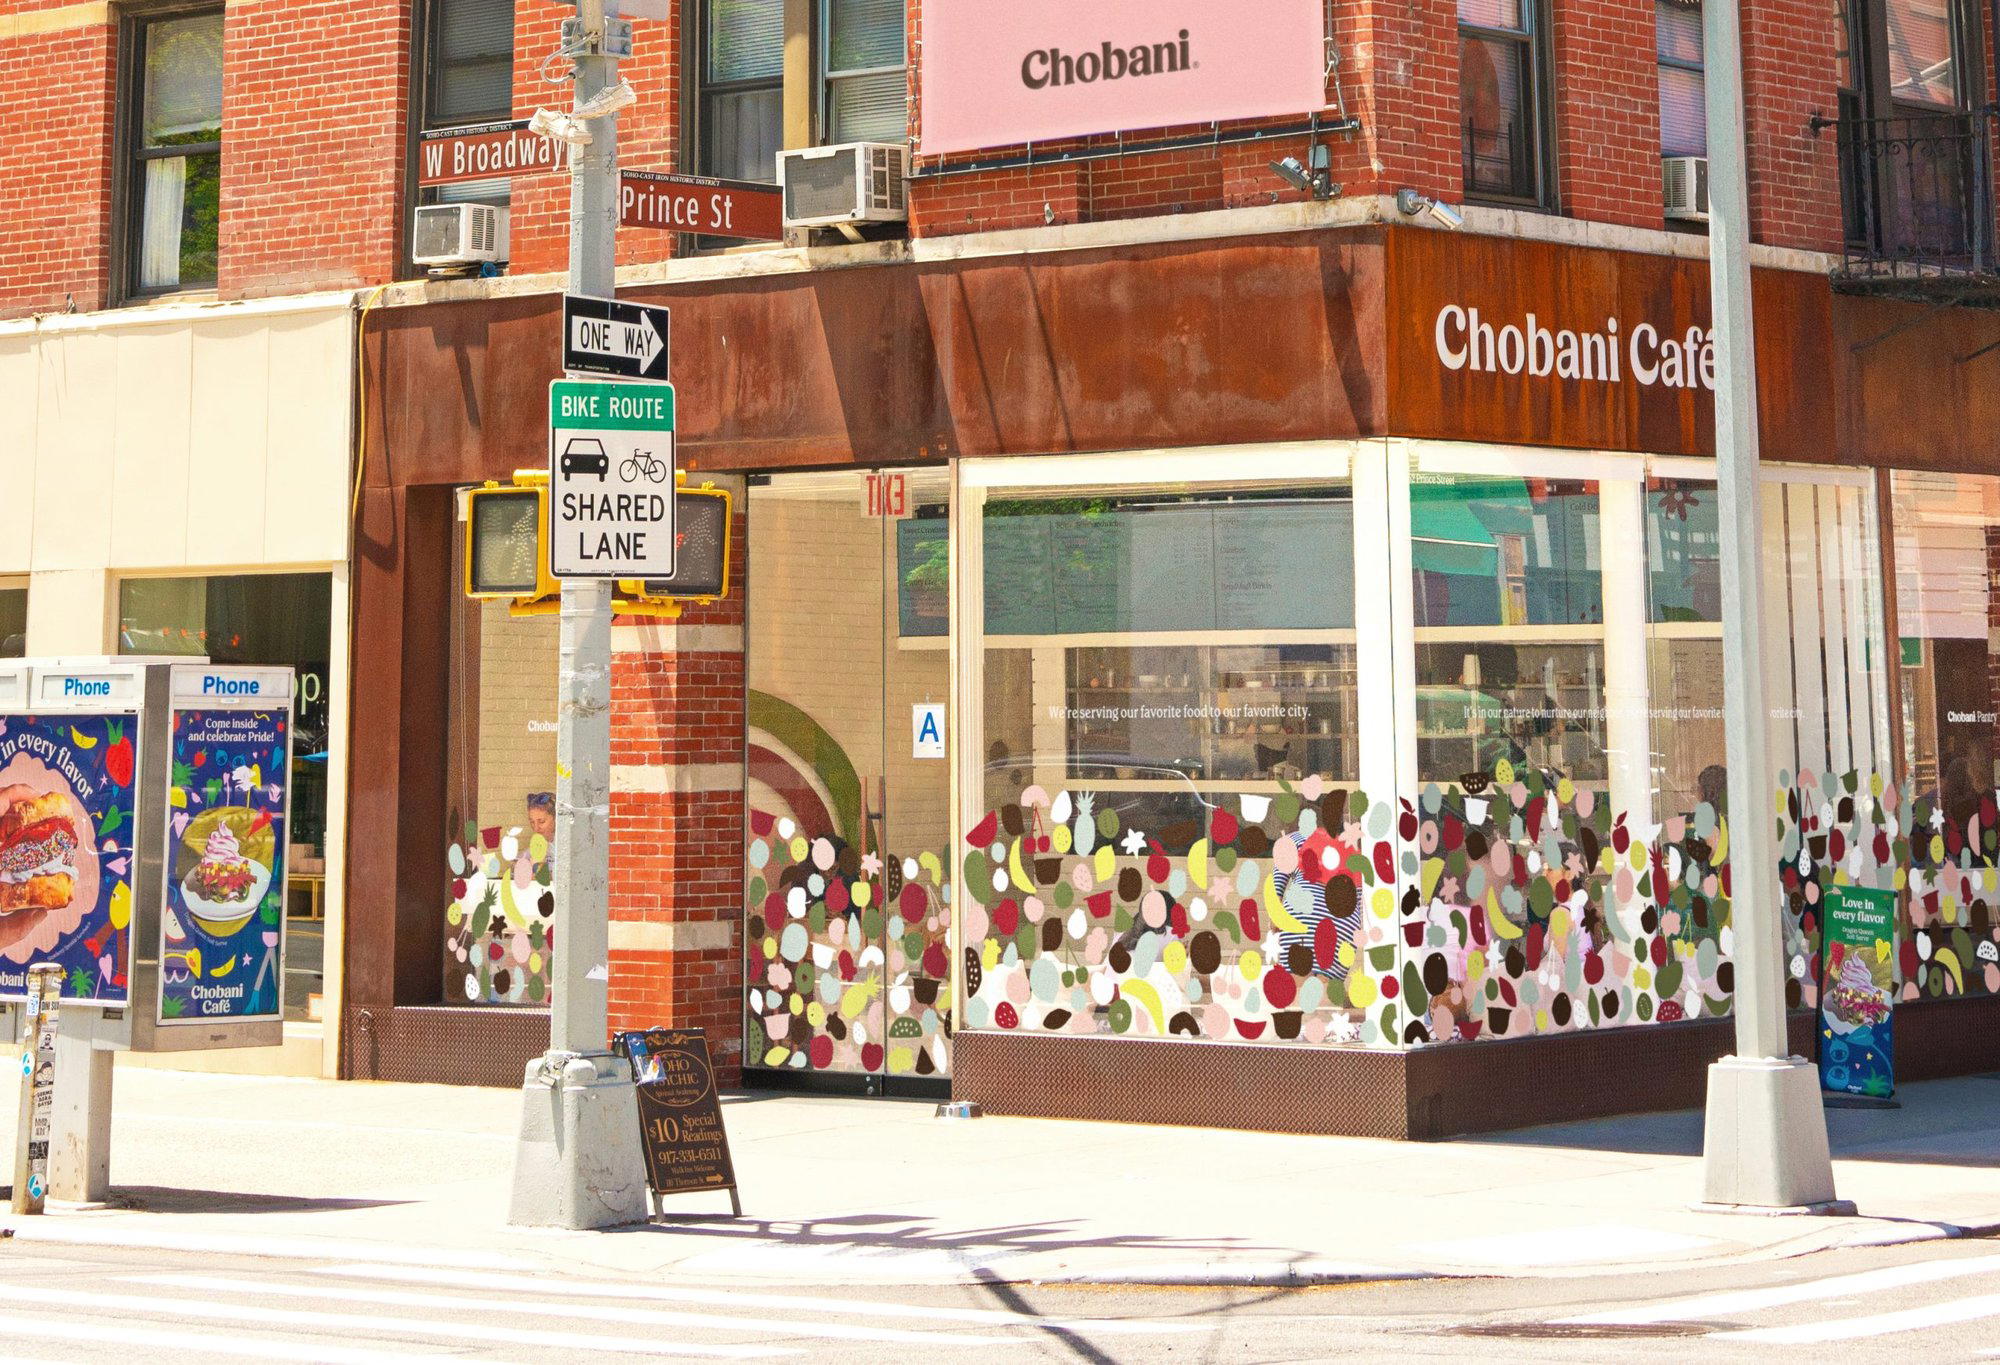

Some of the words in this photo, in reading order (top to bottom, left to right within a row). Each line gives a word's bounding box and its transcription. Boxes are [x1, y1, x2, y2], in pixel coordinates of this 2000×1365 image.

[1021, 29, 1190, 89] Chobani
[426, 144, 443, 178] W
[453, 132, 564, 175] Broadway
[623, 171, 654, 180] SOHO-CAST
[670, 175, 695, 184] HISTORIC
[695, 178, 720, 187] DISTRICT
[622, 185, 699, 226] Prince
[710, 194, 732, 229] St
[580, 321, 611, 351] ONE
[624, 327, 654, 357] WAY
[1435, 304, 1621, 382] Chobani
[562, 395, 600, 418] BIKE
[609, 396, 665, 419] ROUTE
[562, 493, 665, 522] SHARED
[580, 532, 647, 560] LANE
[64, 678, 110, 696] Phone
[203, 675, 260, 695] Phone
[1048, 706, 1079, 719] We're
[1080, 706, 1119, 722] serving
[1121, 709, 1138, 719] our
[1140, 706, 1182, 719] favorite
[1183, 705, 1209, 719] food
[1210, 706, 1221, 718] to
[1223, 708, 1241, 718] our
[1243, 705, 1286, 718] favorite
[1288, 706, 1312, 720] city.
[1488, 708, 1501, 719] our
[1503, 707, 1530, 719] nature
[1531, 706, 1541, 719] to
[1573, 708, 1587, 719] our
[1650, 706, 1678, 721] serving
[1678, 708, 1691, 719] our
[1692, 706, 1720, 719] favorite
[1947, 710, 1976, 723] Chobani
[1977, 710, 1998, 726] Pantry
[205, 718, 231, 729] Come
[232, 718, 259, 729] inside
[919, 711, 939, 742] A
[188, 730, 205, 742] and
[206, 729, 247, 742] celebrate
[248, 731, 275, 742] Pride!
[0, 739, 17, 760] in
[18, 733, 57, 762] every
[56, 746, 93, 800] flavor
[1842, 896, 1863, 909] Love
[1864, 899, 1875, 910] in
[1832, 910, 1857, 923] every
[1857, 910, 1886, 924] flavor
[0, 971, 24, 987] bani
[191, 982, 244, 1000] Chobani
[202, 999, 230, 1014] Café
[662, 1059, 690, 1073] OHO
[649, 1117, 680, 1144] $10
[682, 1112, 717, 1131] Special
[682, 1128, 723, 1144] Readings
[658, 1147, 722, 1165] 917-331-6511
